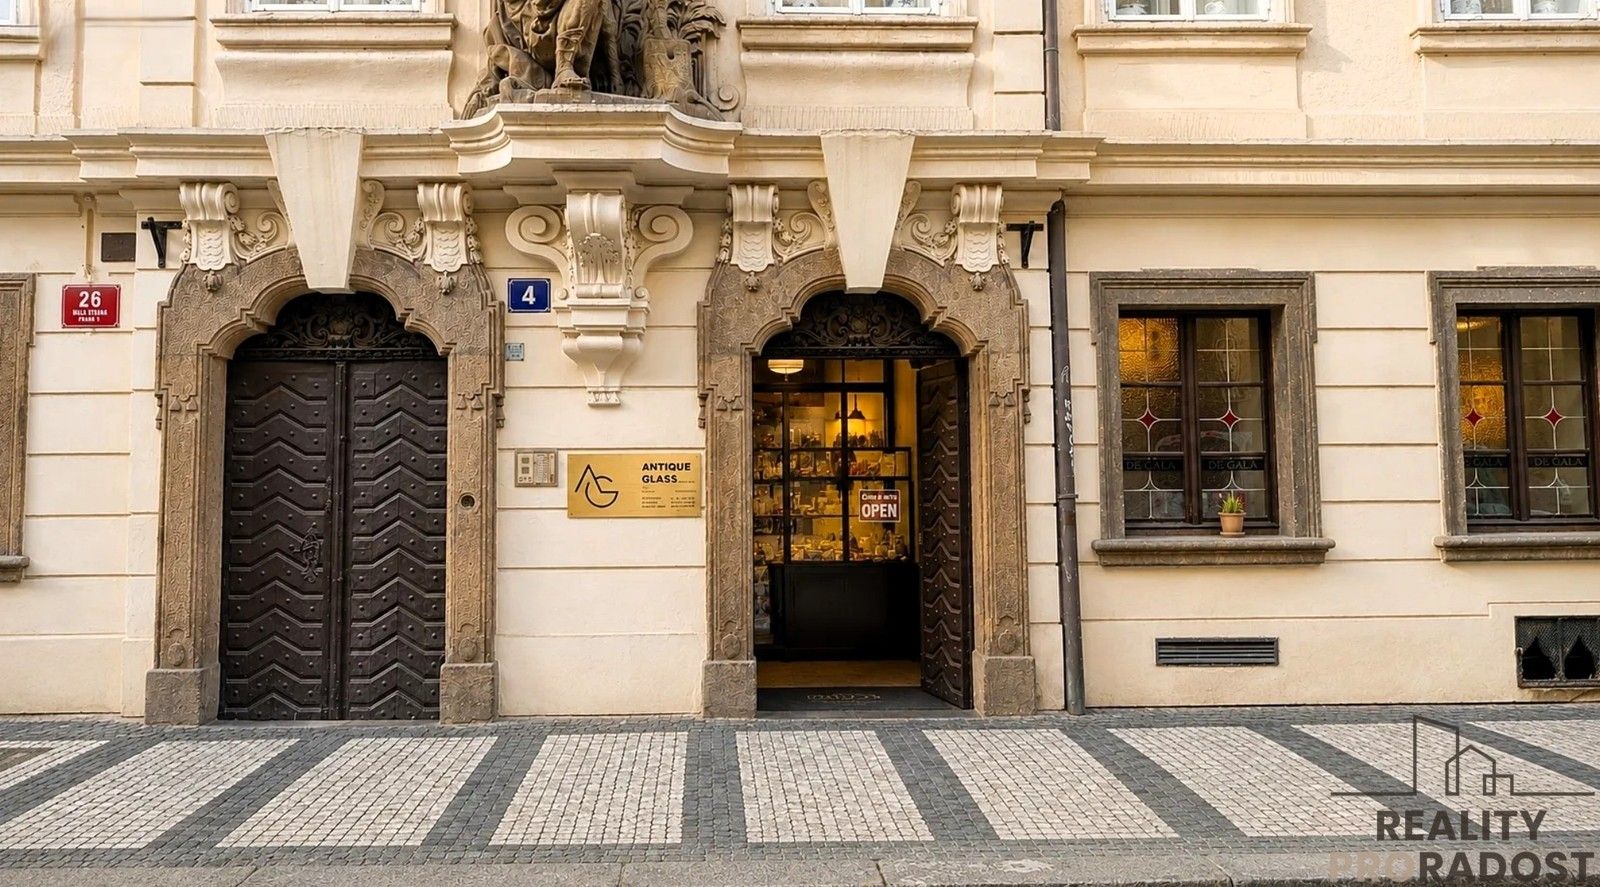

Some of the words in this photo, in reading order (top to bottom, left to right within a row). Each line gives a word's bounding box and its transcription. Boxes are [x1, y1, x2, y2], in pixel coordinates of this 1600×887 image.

[78, 290, 102, 308] 26
[521, 285, 536, 305] 4
[641, 462, 691, 471] ANTIQUE
[1226, 461, 1258, 470] GALA
[1534, 457, 1551, 466] DE
[1552, 457, 1583, 466] GALA
[641, 474, 678, 484] GLASS
[861, 503, 897, 518] OPEN
